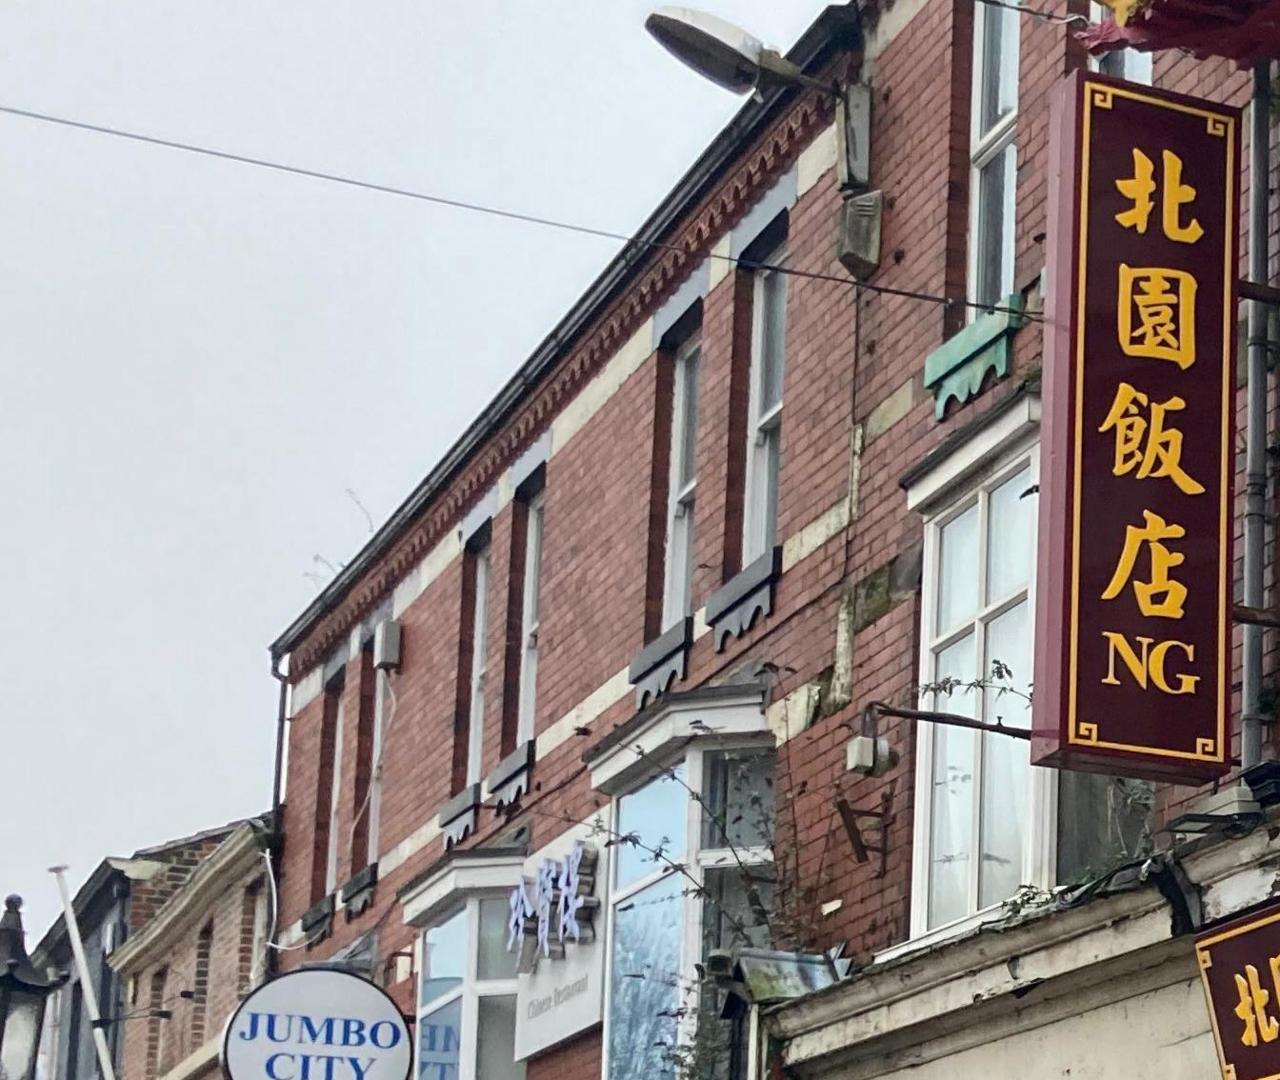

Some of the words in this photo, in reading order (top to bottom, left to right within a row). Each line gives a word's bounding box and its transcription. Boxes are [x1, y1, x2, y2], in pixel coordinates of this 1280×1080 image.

[1098, 146, 1206, 621] 北園飯店
[1101, 631, 1200, 696] NG
[239, 1012, 402, 1050] JUMBO
